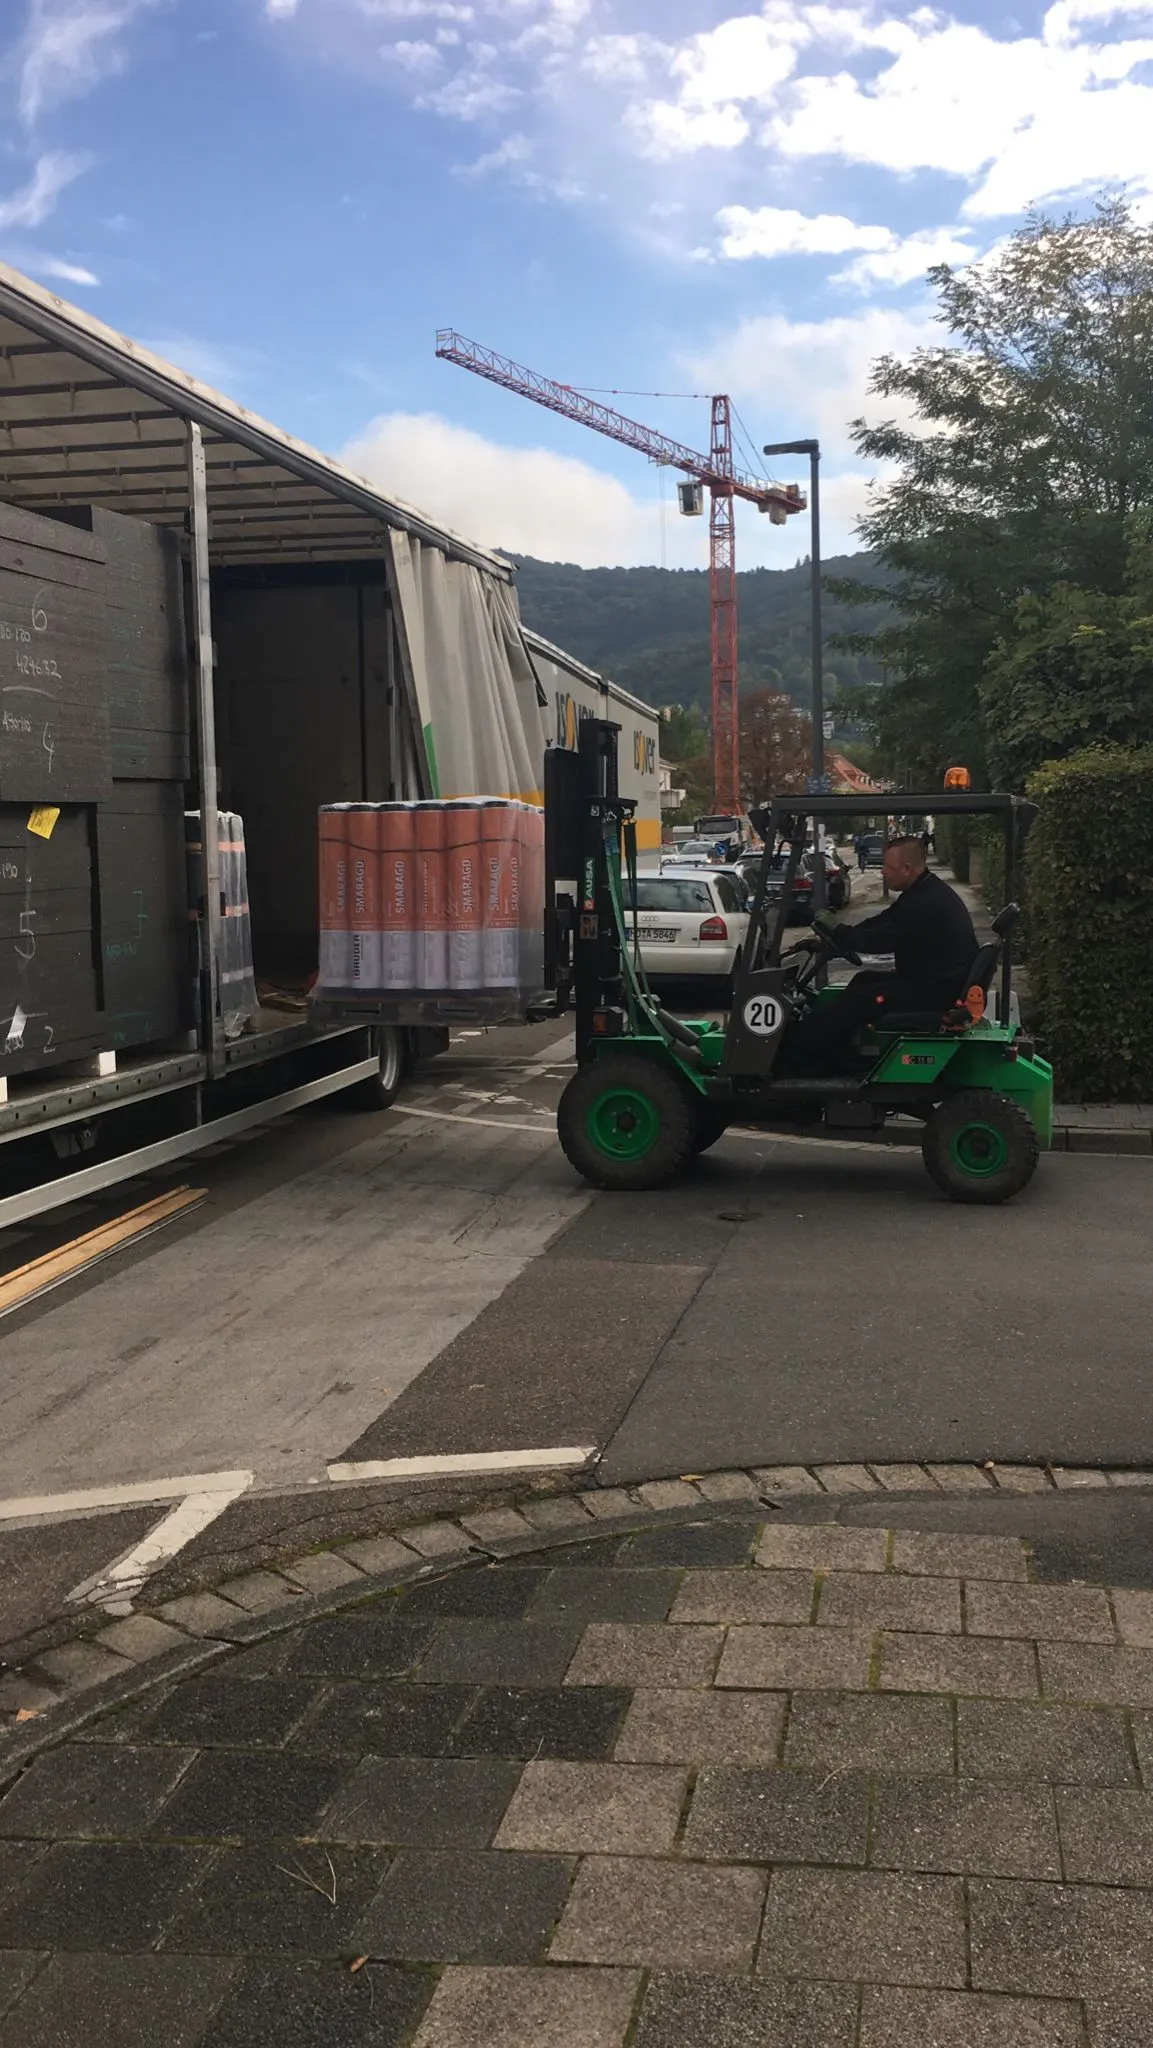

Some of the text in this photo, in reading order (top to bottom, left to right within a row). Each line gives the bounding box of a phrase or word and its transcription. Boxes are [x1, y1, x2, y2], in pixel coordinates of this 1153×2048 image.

[31, 587, 48, 632] 6
[355, 859, 364, 914] SMARAGD
[395, 860, 405, 914] SMARAGD
[462, 859, 473, 914] SMARAGD
[585, 859, 593, 899] AUSA
[646, 930, 651, 938] A
[653, 930, 674, 939] 5846
[751, 1002, 776, 1027] 20
[43, 1025, 56, 1054] 2
